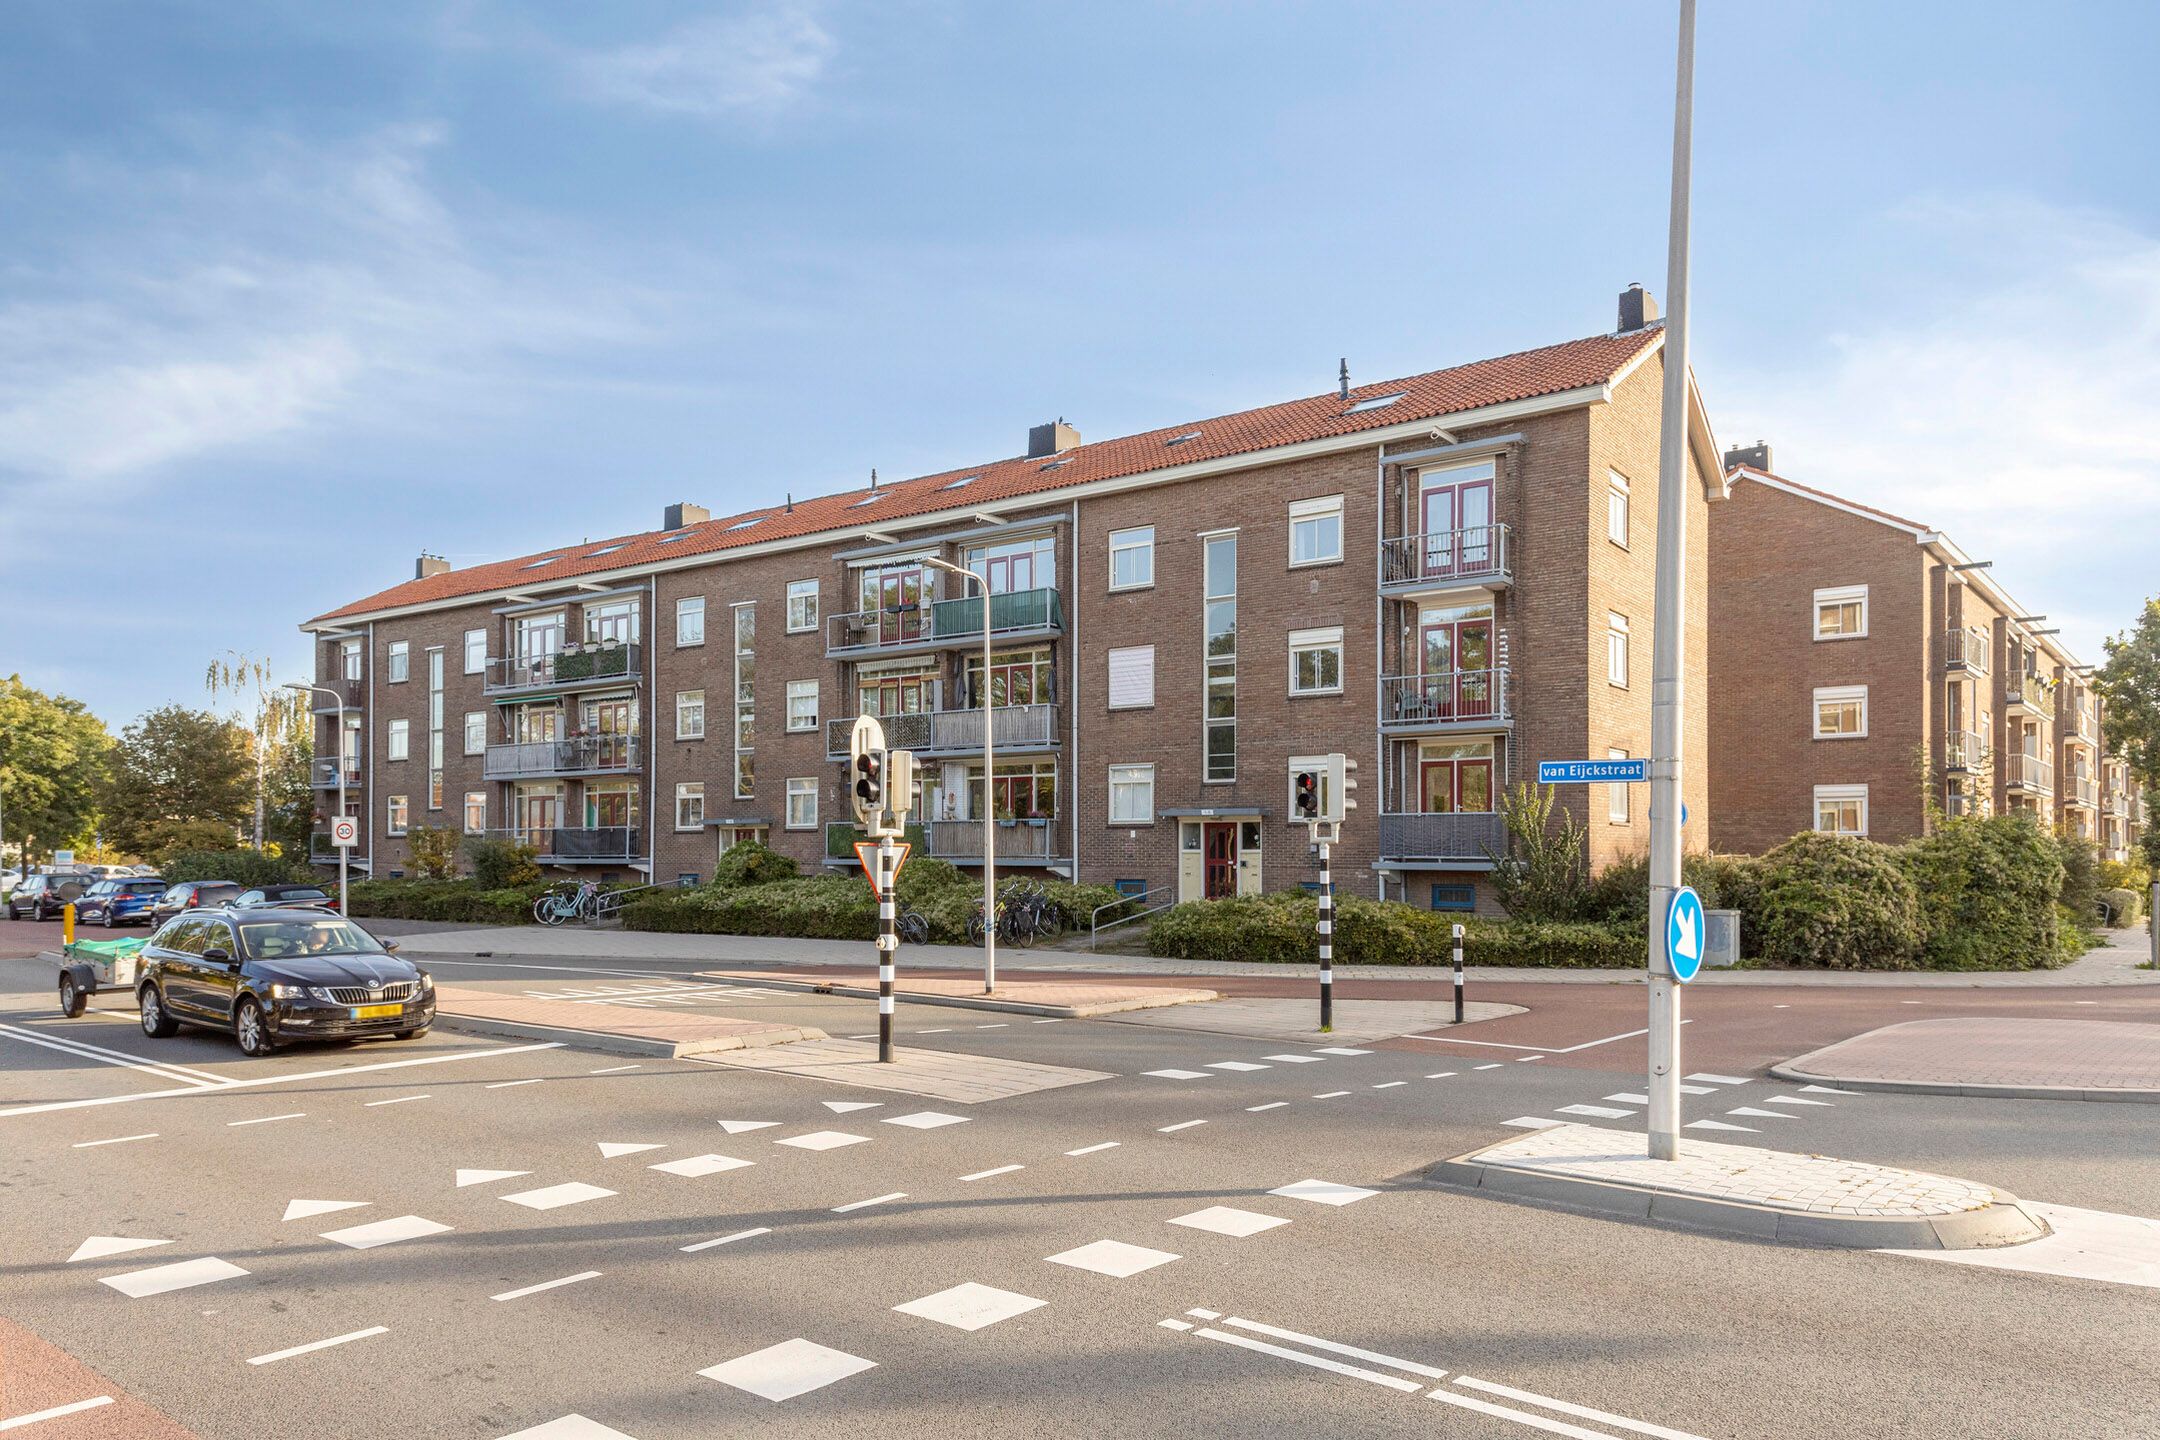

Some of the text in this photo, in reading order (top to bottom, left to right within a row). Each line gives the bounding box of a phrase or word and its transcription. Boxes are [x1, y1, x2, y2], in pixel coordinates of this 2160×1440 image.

[1543, 764, 1641, 779] van Eijckstraat
[339, 827, 351, 835] 30
